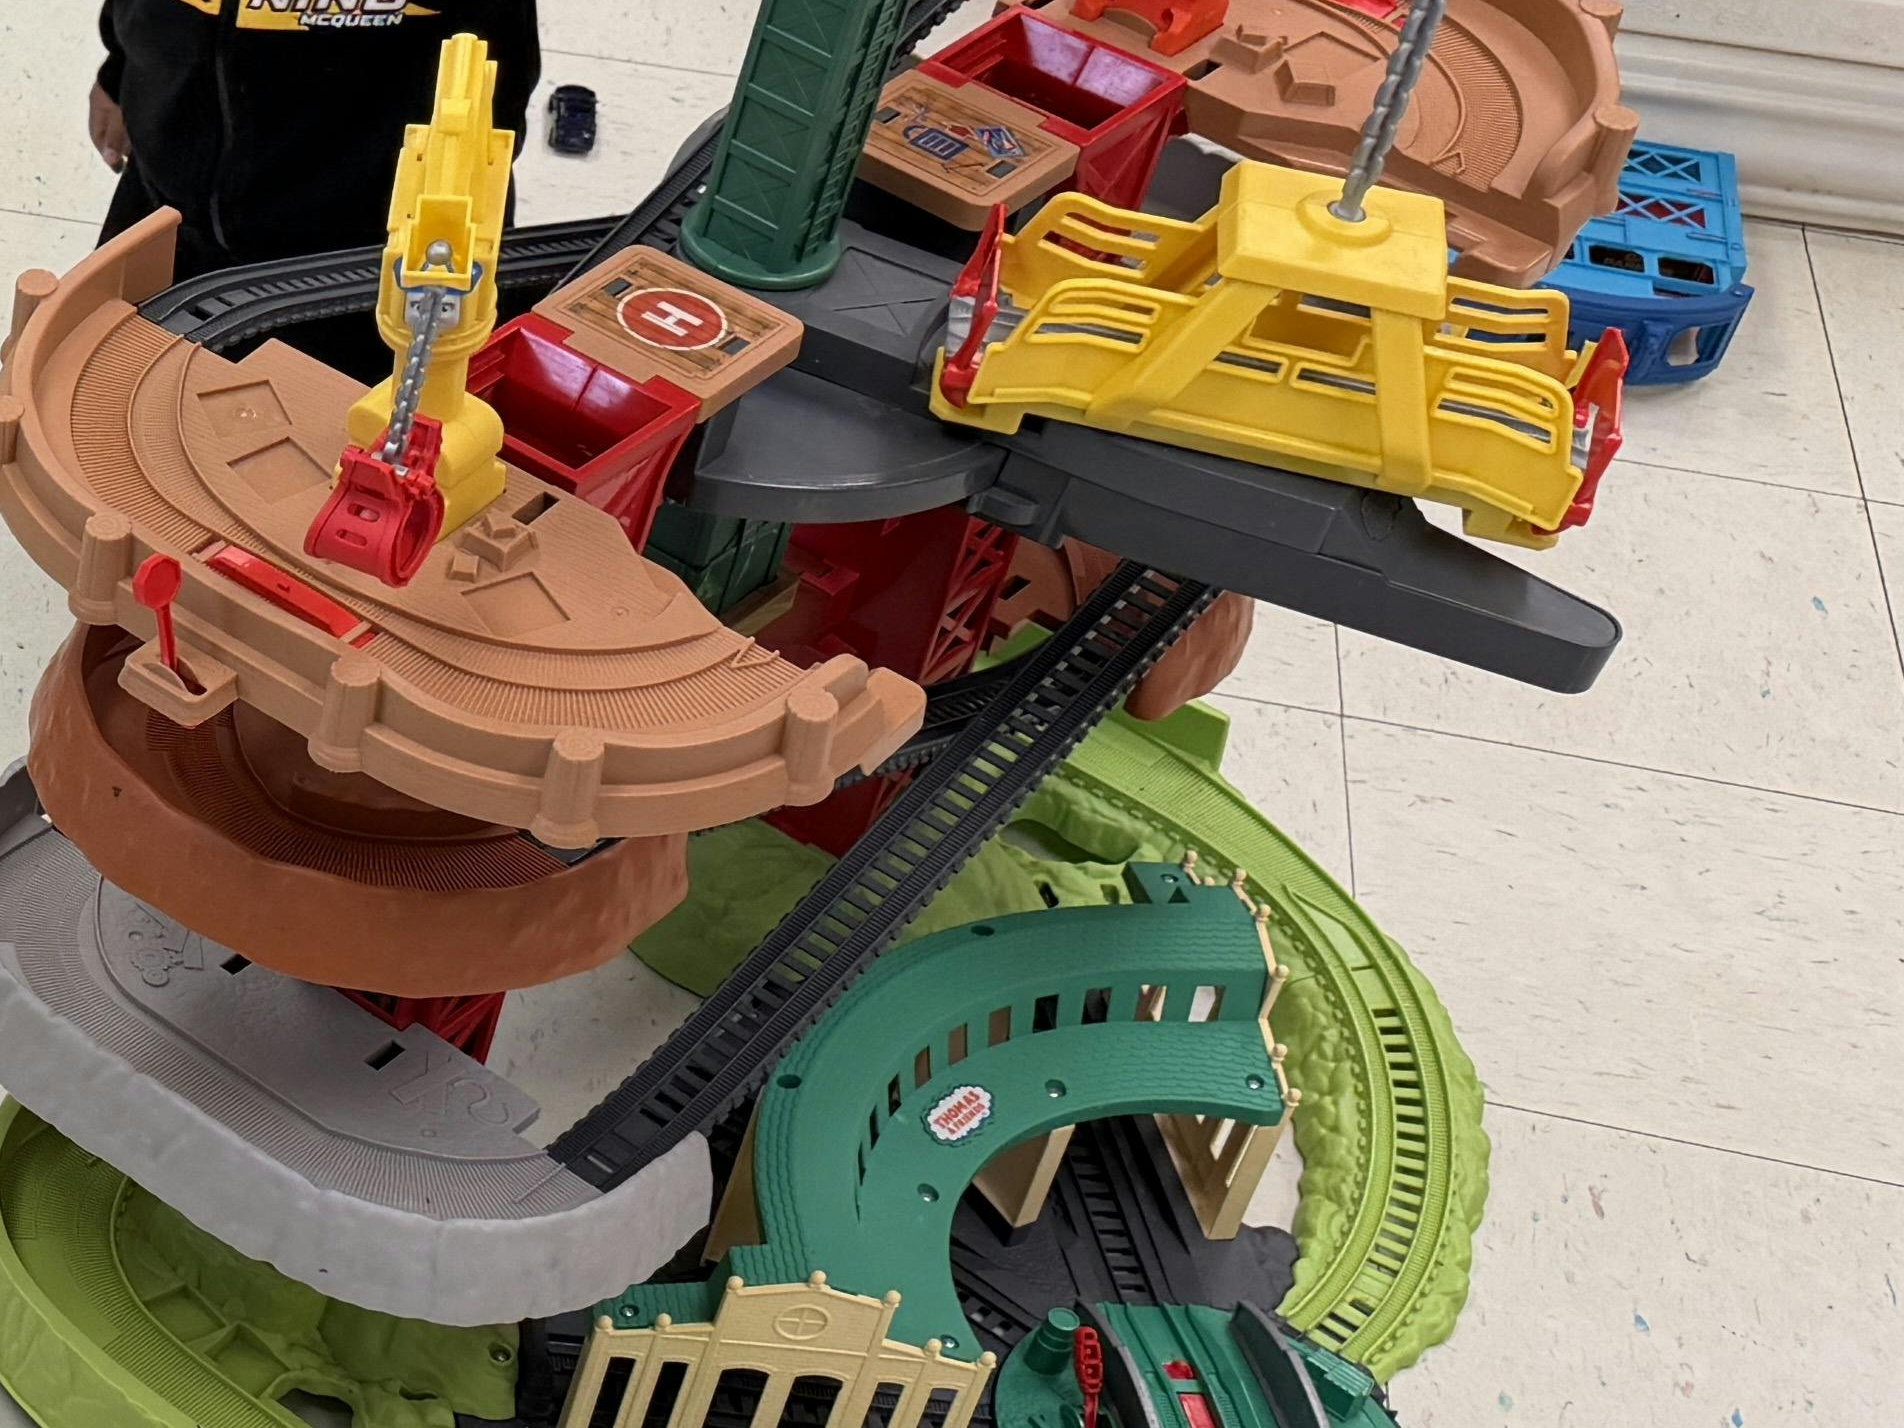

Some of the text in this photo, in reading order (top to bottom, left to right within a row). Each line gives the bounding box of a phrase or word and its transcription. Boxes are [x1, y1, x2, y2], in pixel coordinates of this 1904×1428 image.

[299, 13, 404, 28] MCQUEEN
[641, 301, 704, 337] H
[933, 1090, 981, 1128] THOMAS
